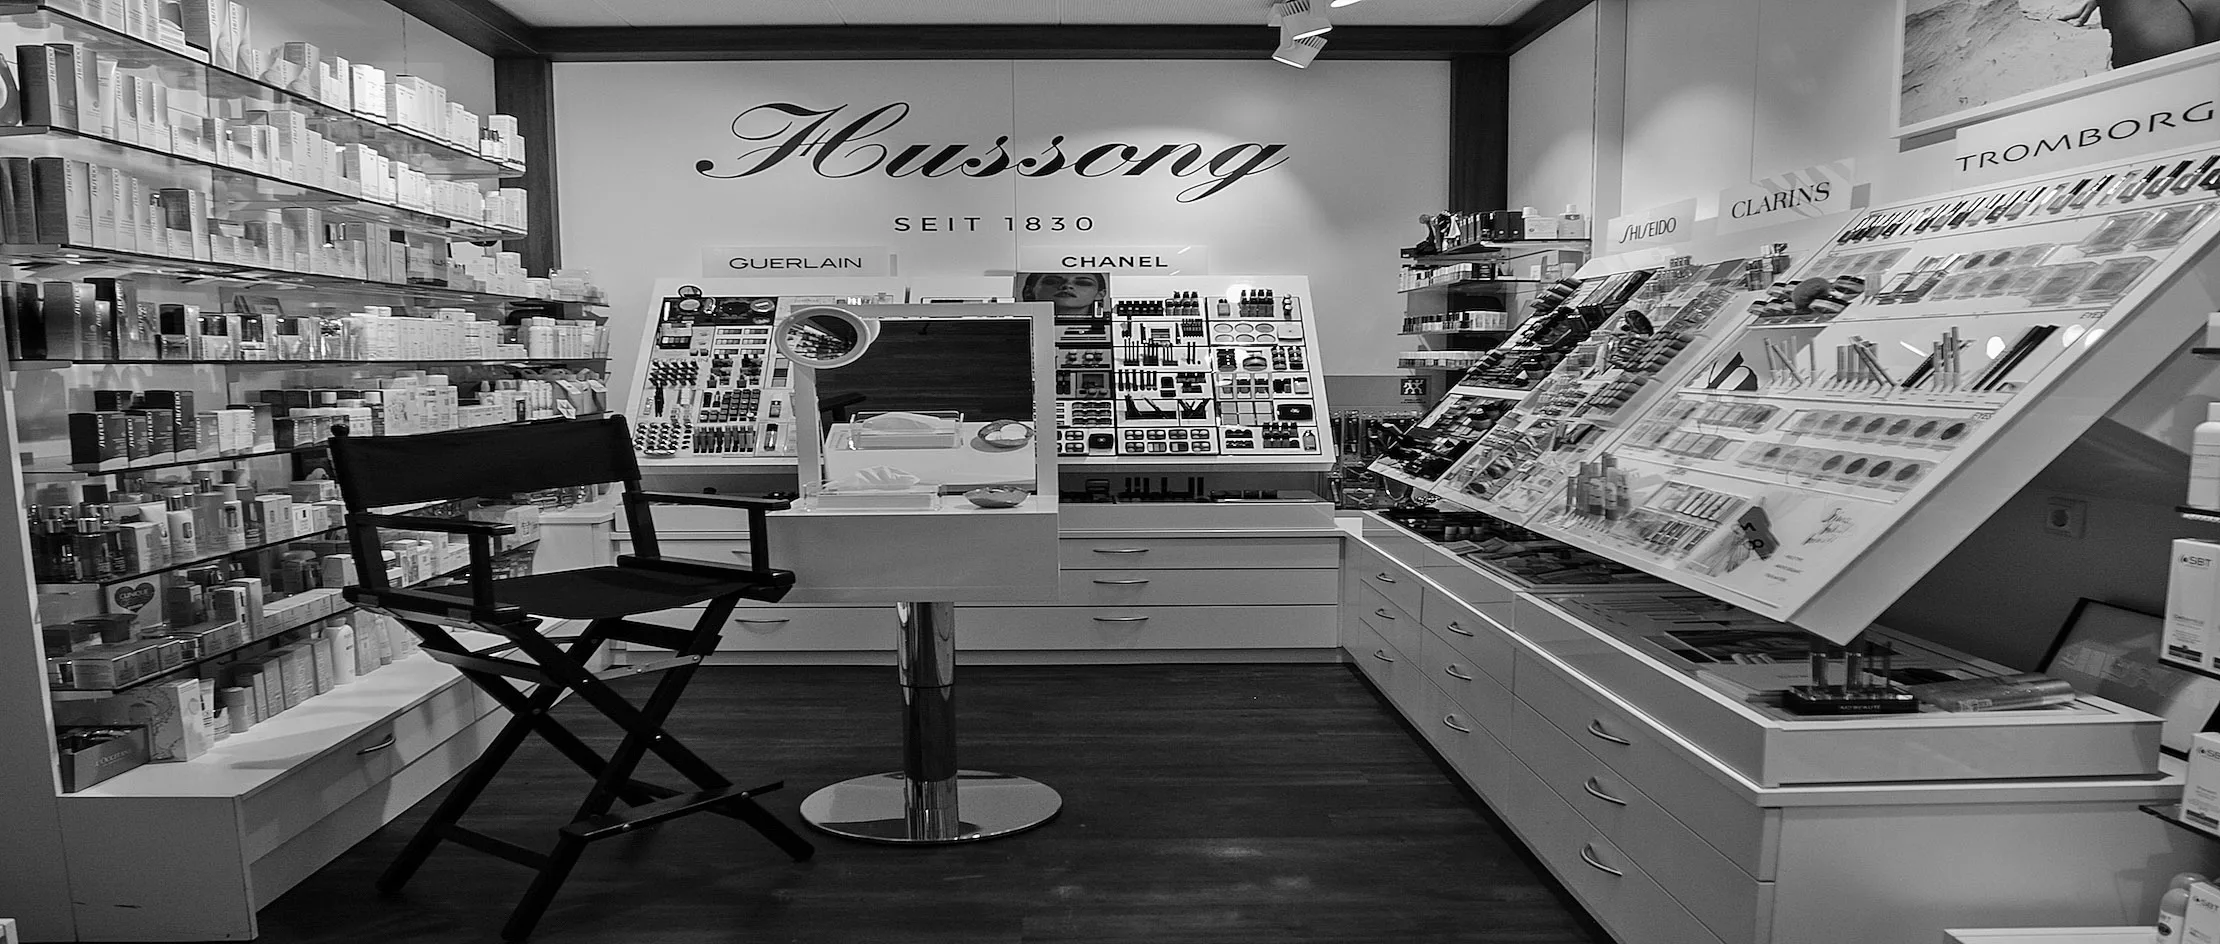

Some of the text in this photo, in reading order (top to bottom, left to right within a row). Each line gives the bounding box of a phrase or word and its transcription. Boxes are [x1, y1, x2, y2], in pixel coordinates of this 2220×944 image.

[1955, 100, 2215, 171] TROMBORG
[695, 101, 1291, 204] Hussong
[1731, 181, 1831, 219] CLARINS
[893, 216, 1095, 232] SEIT 1830
[1619, 217, 1678, 244] SHISEIDO
[729, 256, 863, 270] GUERLAIN
[1061, 255, 1169, 268] CHANEL
[2189, 556, 2212, 567] SBT
